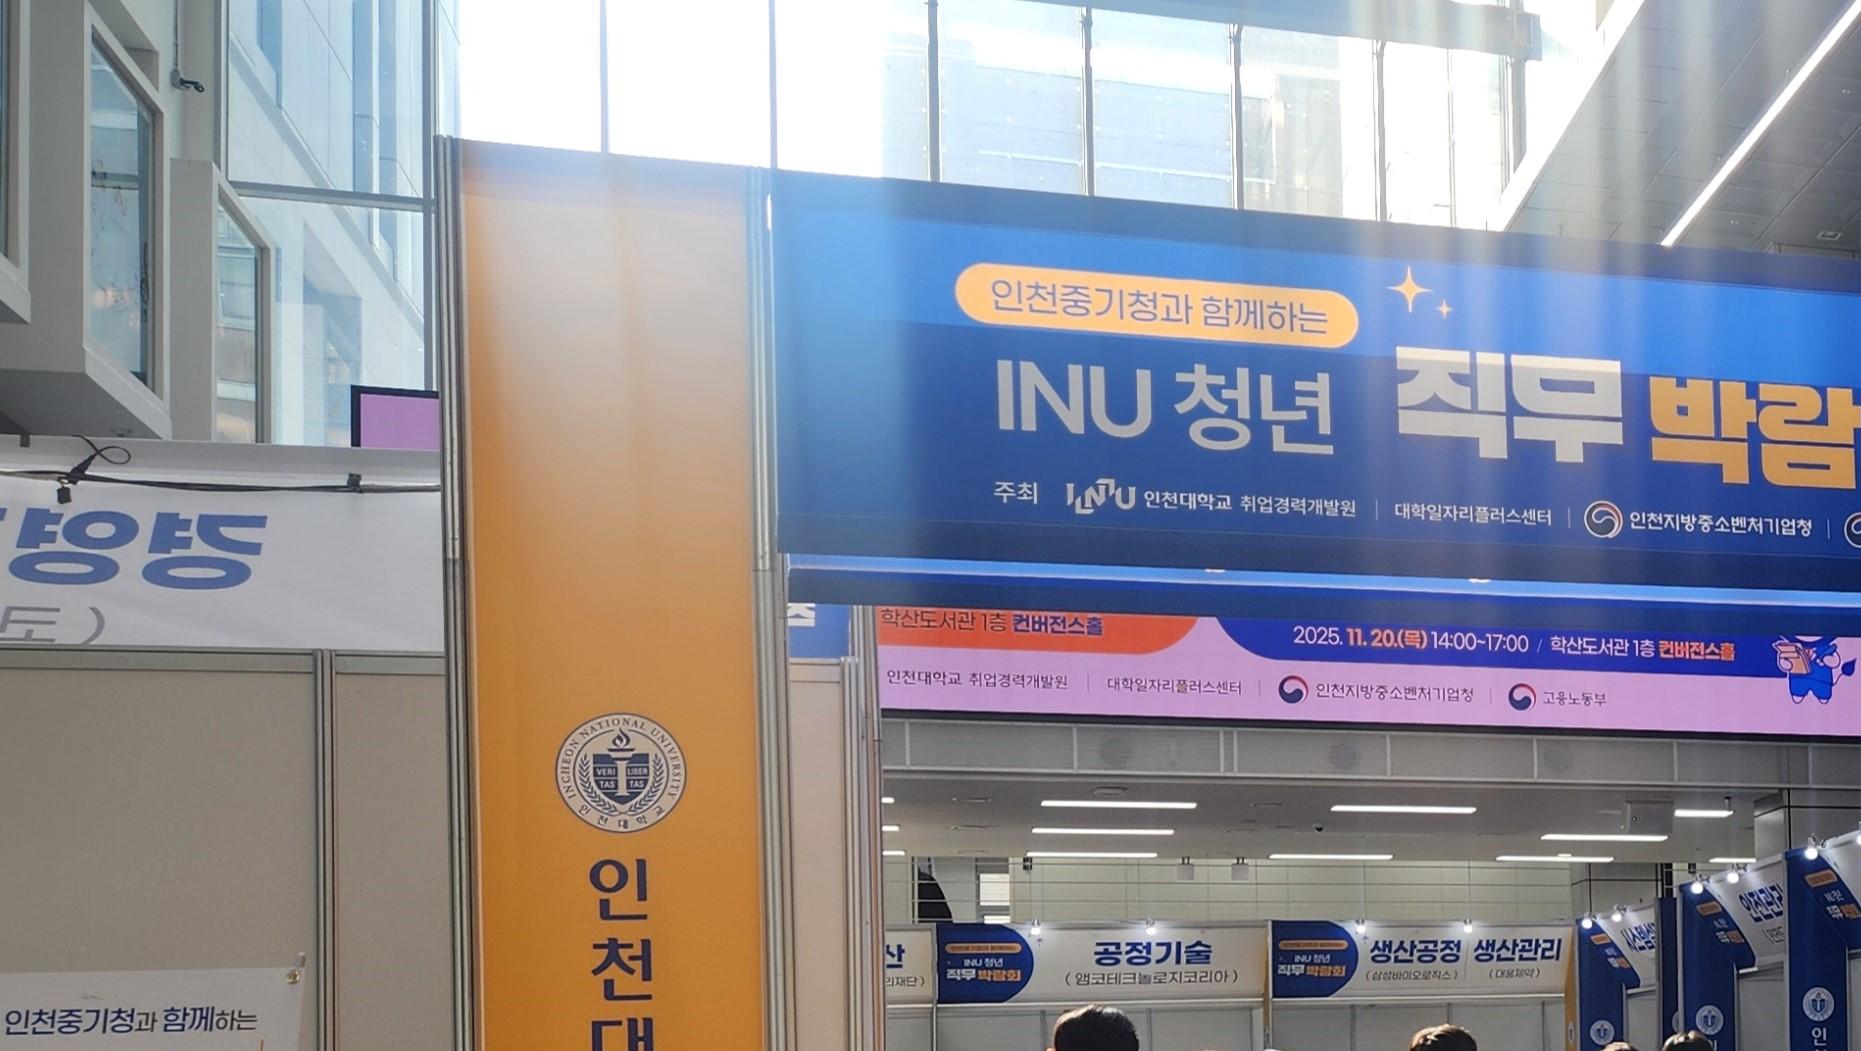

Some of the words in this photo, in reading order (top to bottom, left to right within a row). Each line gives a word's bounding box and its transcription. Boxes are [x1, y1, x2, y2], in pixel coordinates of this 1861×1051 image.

[991, 279, 1192, 325] 인천중기청과
[1201, 295, 1329, 334] 함께하는
[997, 360, 1152, 438] INU
[1174, 363, 1334, 455] 청년
[1396, 346, 1623, 463] 직무
[993, 481, 1038, 505] 주최
[1144, 490, 1232, 512] 인천대학교
[1240, 495, 1356, 518] 취업경력개발원
[1394, 502, 1552, 526] 대학일자리플러스센터
[1629, 512, 1812, 538] 인천지방중소벤처기업청
[880, 607, 976, 633] 학산도서관
[981, 613, 1007, 633] 1층
[1012, 614, 1104, 637] 컨버전스홀
[1293, 625, 1343, 646] 2025.
[1346, 627, 1367, 647] 11.
[1371, 627, 1428, 650] 20.(목)
[1431, 630, 1530, 653] 14:00~17:00
[1550, 635, 1630, 657] 학산도서관
[1632, 638, 1655, 658] 1층
[1658, 639, 1736, 662] 컨버전스홀
[887, 668, 962, 687] 인천대학교
[968, 671, 1068, 691] 취업경력개발원
[1107, 676, 1243, 697] 대학일자리플러스센터
[1315, 681, 1475, 704] 인천지방중소벤처기업청
[1542, 690, 1607, 708] 고용노동부
[561, 740, 580, 800] INCHEON
[579, 717, 646, 740] NATIONAL
[650, 727, 682, 801] UNIVERSITY
[1094, 939, 1213, 967] 공정기술
[1369, 938, 1462, 964] 생산공정
[1473, 938, 1562, 962] 생산관리
[5, 1007, 158, 1036] 인천중기청과
[163, 1006, 258, 1032] 함께하는
